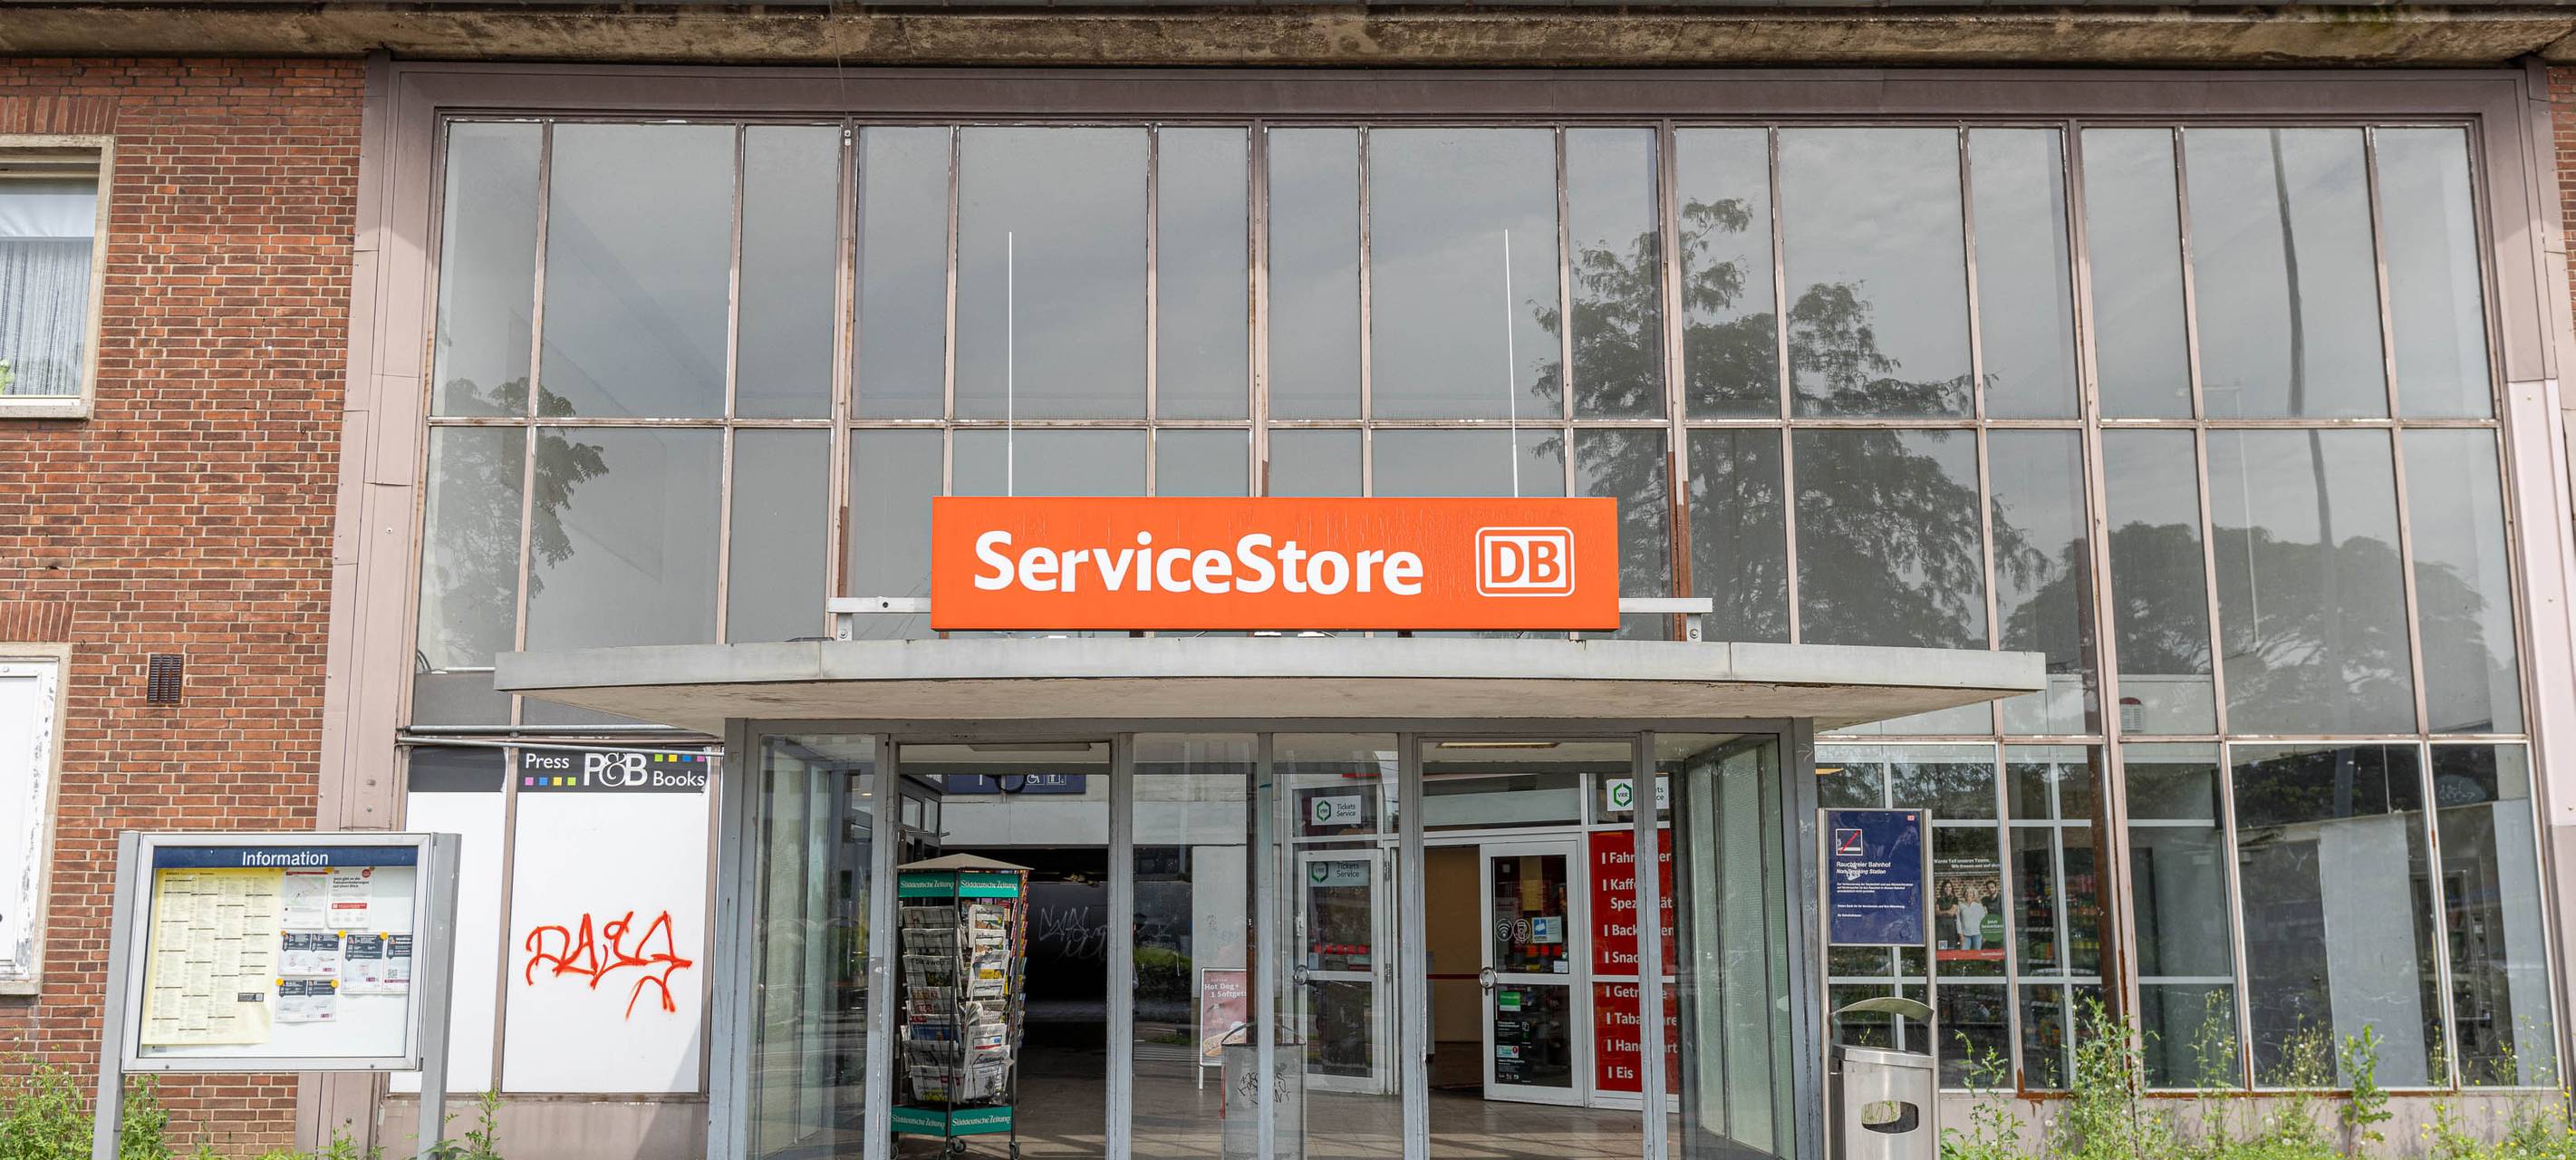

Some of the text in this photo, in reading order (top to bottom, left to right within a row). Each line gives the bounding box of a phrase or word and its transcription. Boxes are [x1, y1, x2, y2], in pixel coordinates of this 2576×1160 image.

[974, 530, 1423, 595] ServiceStore
[1489, 536, 1563, 585] DB
[525, 753, 570, 769] Press
[583, 752, 649, 787] P&B
[652, 770, 706, 788] Books
[241, 851, 329, 866] Information
[1336, 862, 1360, 870] Tickets
[1336, 870, 1360, 878] Service
[933, 880, 954, 890] Zeitung
[960, 880, 1018, 891] Süddeutsche Zeitung
[1616, 1067, 1634, 1078] Eis
[892, 1115, 946, 1130] Süddeutsche Zeitung
[952, 1115, 1011, 1126] Süddeutsche Zeitung
